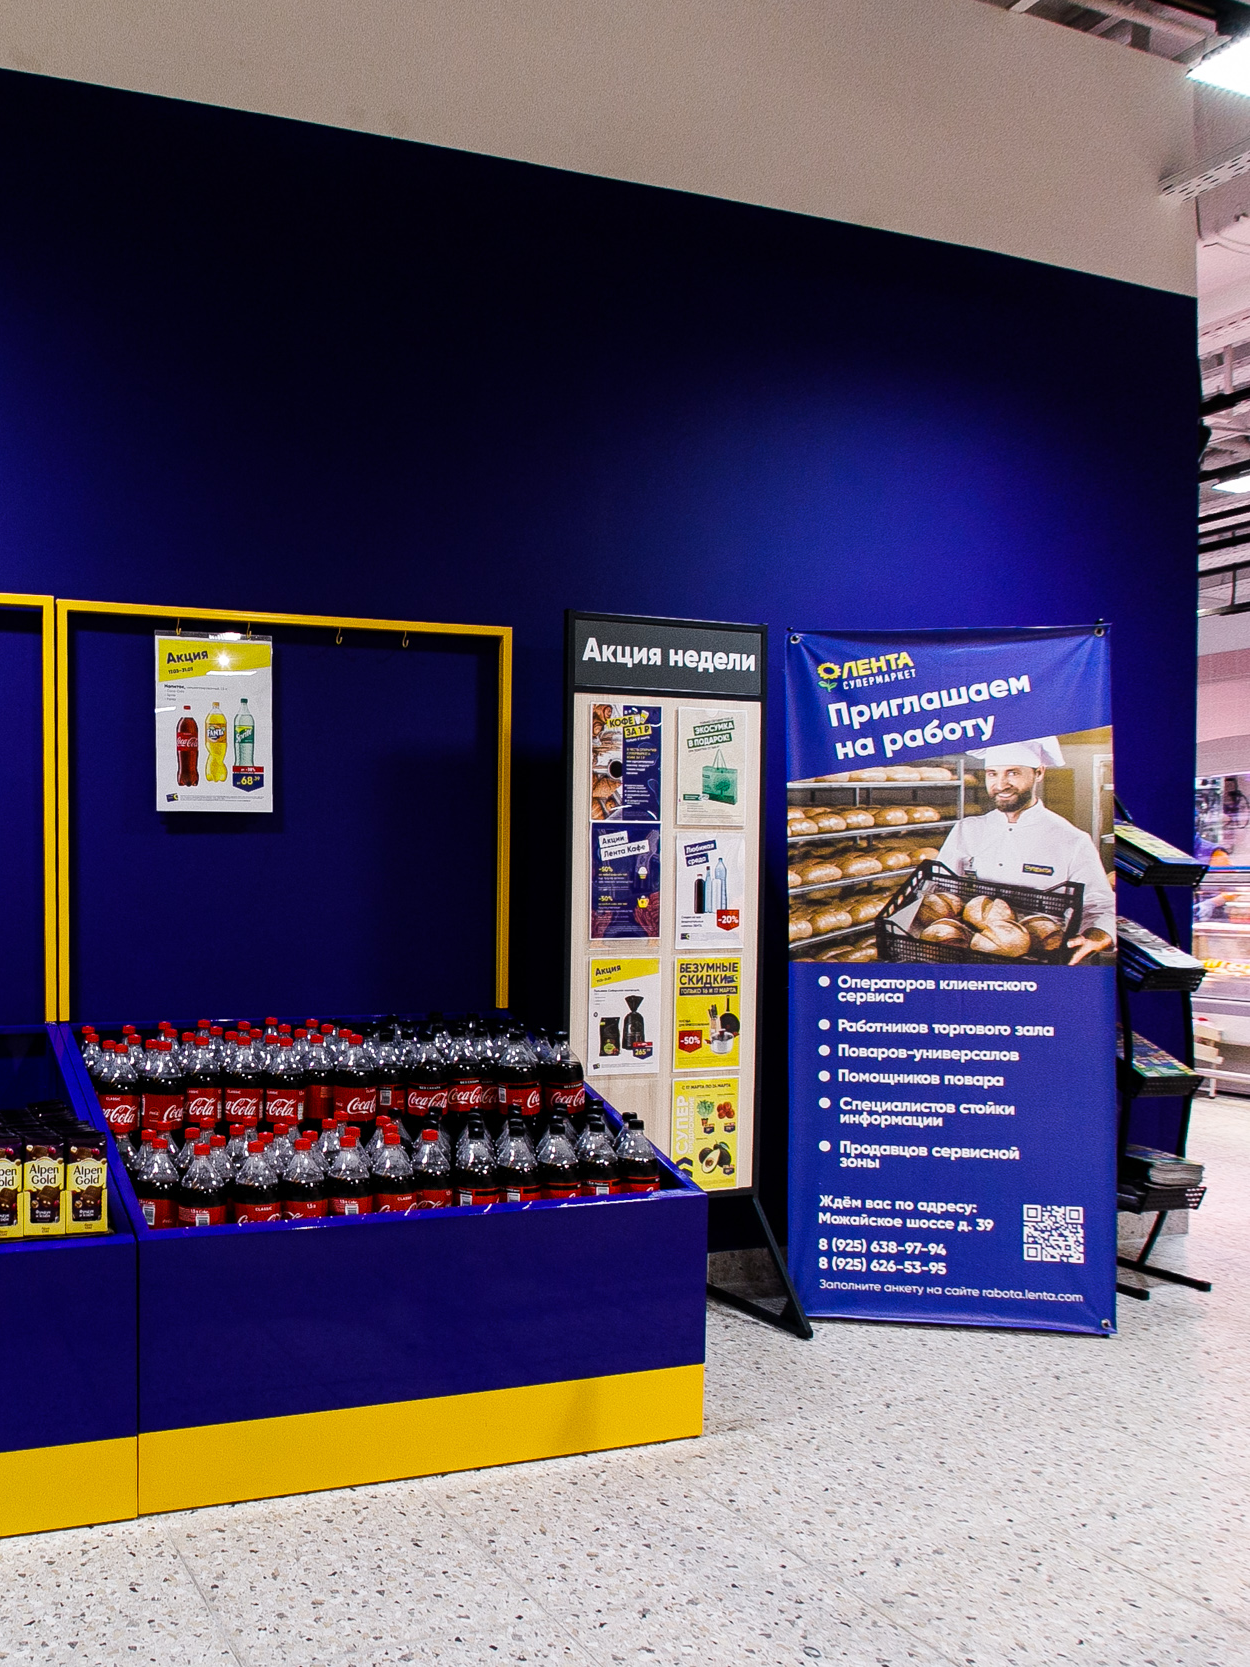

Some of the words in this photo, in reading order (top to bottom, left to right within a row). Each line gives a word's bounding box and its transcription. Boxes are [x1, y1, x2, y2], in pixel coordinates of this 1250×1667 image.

[167, 650, 209, 665] Акция
[582, 637, 662, 668] Акция
[669, 648, 756, 673] недели
[842, 651, 915, 679] ЛЕНТА
[843, 668, 916, 690] СУПЕРМАРКЕТ
[828, 675, 1031, 729] Приглашаем
[609, 717, 633, 728] КОФЕ
[694, 721, 734, 735] ЭКОСУМКА
[625, 728, 636, 736] ЗА
[638, 727, 643, 735] 1
[835, 736, 875, 760] на
[883, 715, 996, 758] работу
[694, 734, 730, 747] ПОДАРОК!
[602, 836, 625, 845] Акции
[604, 849, 626, 858] Лента
[687, 856, 707, 866] среда
[718, 915, 739, 924] -20%
[595, 965, 622, 976] Акция
[679, 962, 739, 974] БЕЗУМНЫЕ
[679, 974, 727, 987] СКИДКИ
[837, 975, 935, 992] Операторов
[939, 978, 1037, 992] клиентского
[837, 992, 904, 1005] сервиса
[838, 1018, 928, 1034] Работников
[932, 1023, 1011, 1037] торгового
[1015, 1025, 1055, 1037] зала
[680, 1036, 701, 1045] -50%
[838, 1044, 1020, 1062] Поваров-универсалов
[838, 1069, 940, 1085] Помощников
[944, 1075, 1004, 1089] повара
[839, 1097, 955, 1113] Специалистов
[959, 1102, 1016, 1116] стойки
[675, 1095, 689, 1155] СУПЕР
[840, 1112, 943, 1128] информации
[839, 1140, 928, 1157] Продавцов
[932, 1146, 1020, 1161] сервисной
[839, 1156, 880, 1168] зоны
[29, 1164, 60, 1176] Alpen
[73, 1164, 103, 1176] Alpen
[31, 1174, 57, 1185] Gold
[75, 1174, 100, 1185] Gold
[819, 1195, 861, 1210] Ждём
[866, 1199, 892, 1210] вас
[895, 1200, 914, 1211] по
[918, 1201, 977, 1215] адресу:
[818, 1212, 902, 1228] Можайское
[906, 1217, 954, 1230] шоссе
[958, 1219, 972, 1232] д.
[976, 1218, 994, 1232] 39
[818, 1239, 828, 1251] 8
[832, 1238, 867, 1253] (925)
[870, 1240, 947, 1256] 638-97-94
[818, 1257, 828, 1270] 8
[832, 1256, 867, 1272] (925)
[870, 1259, 947, 1275] 626-53-95
[819, 1279, 882, 1293] Заполните
[884, 1284, 924, 1296] анкету
[926, 1286, 942, 1295] на
[944, 1286, 980, 1297] сайте
[982, 1287, 1084, 1302] rabota.lenta.com
